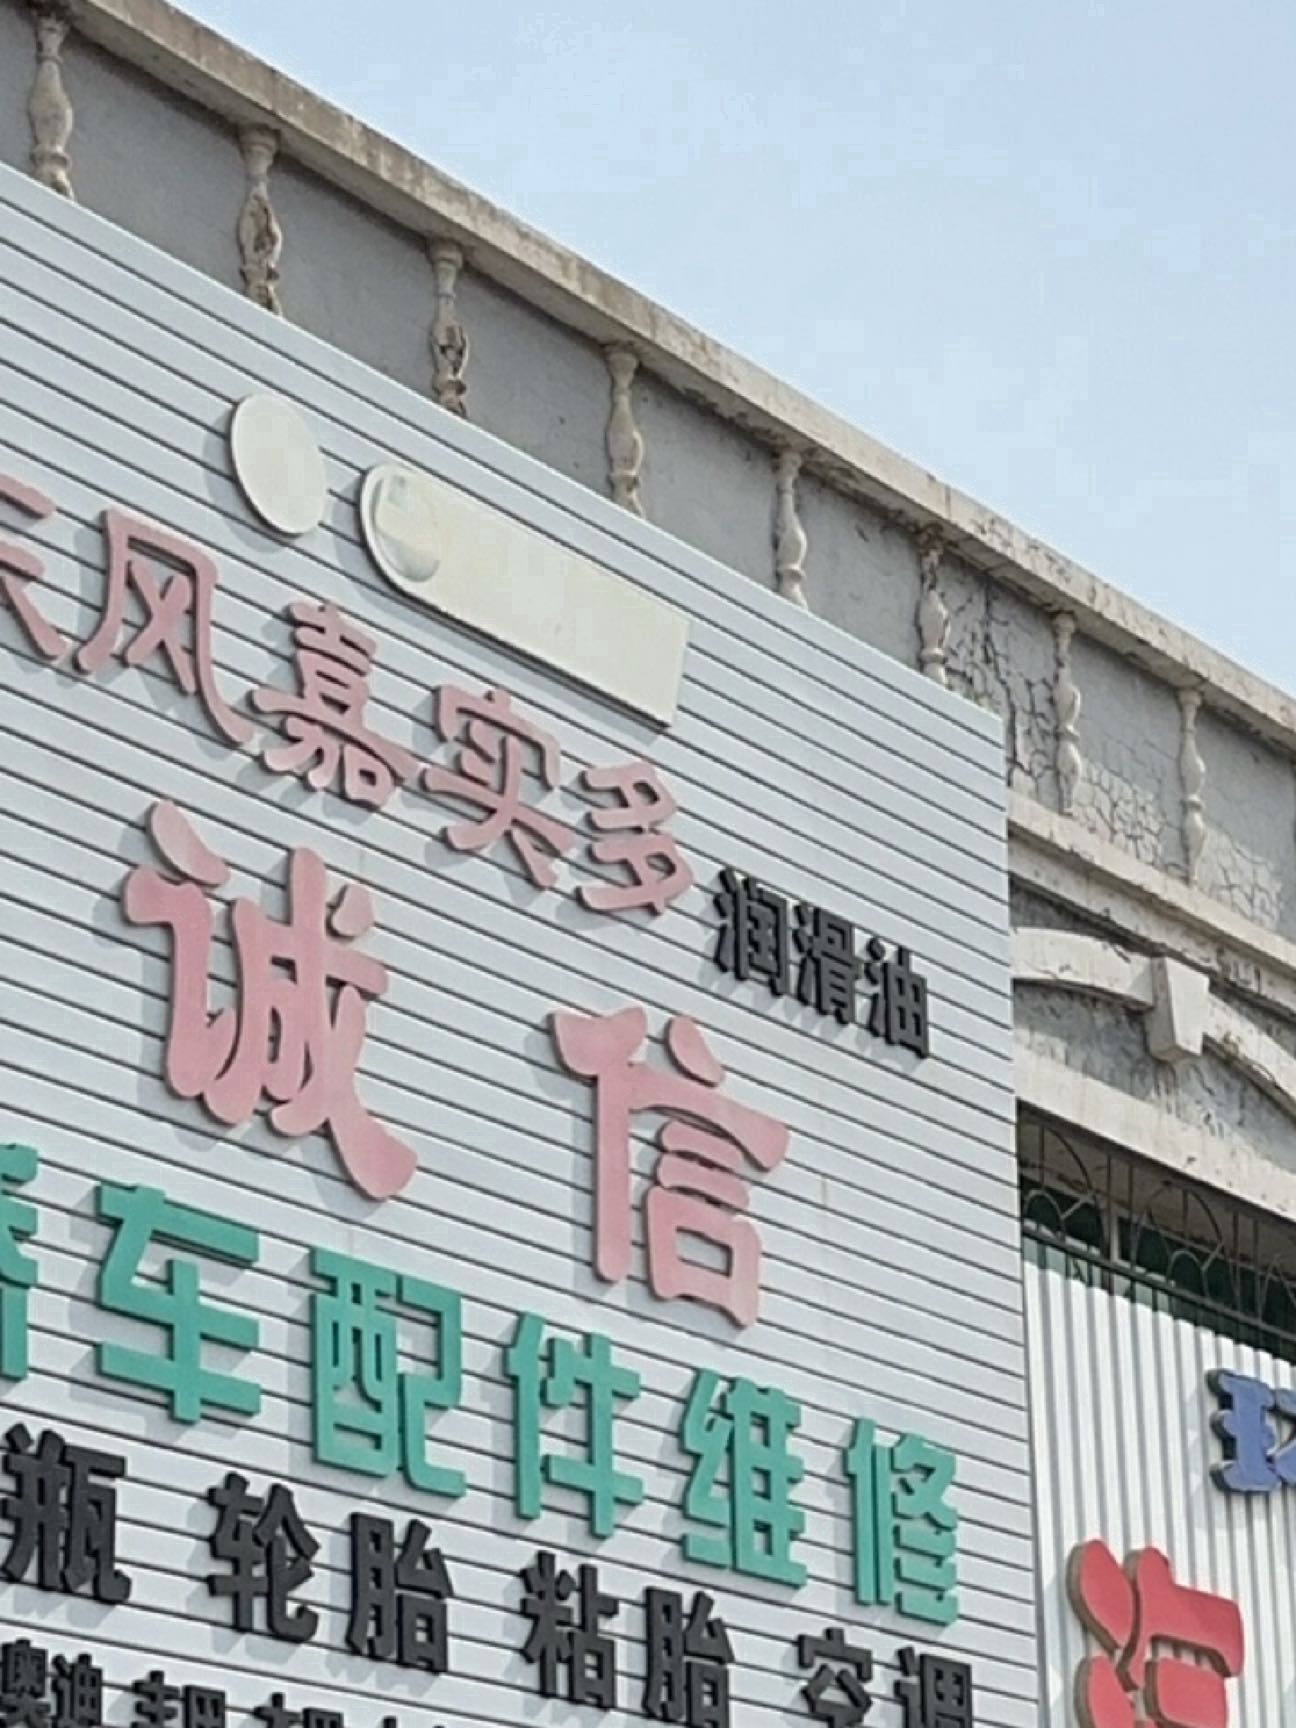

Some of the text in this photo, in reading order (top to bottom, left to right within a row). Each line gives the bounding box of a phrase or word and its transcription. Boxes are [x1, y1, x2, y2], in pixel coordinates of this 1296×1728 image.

[122, 799, 791, 1328] 诚信
[713, 867, 931, 1059] 润滑油
[207, 1472, 455, 1673] 轮胎
